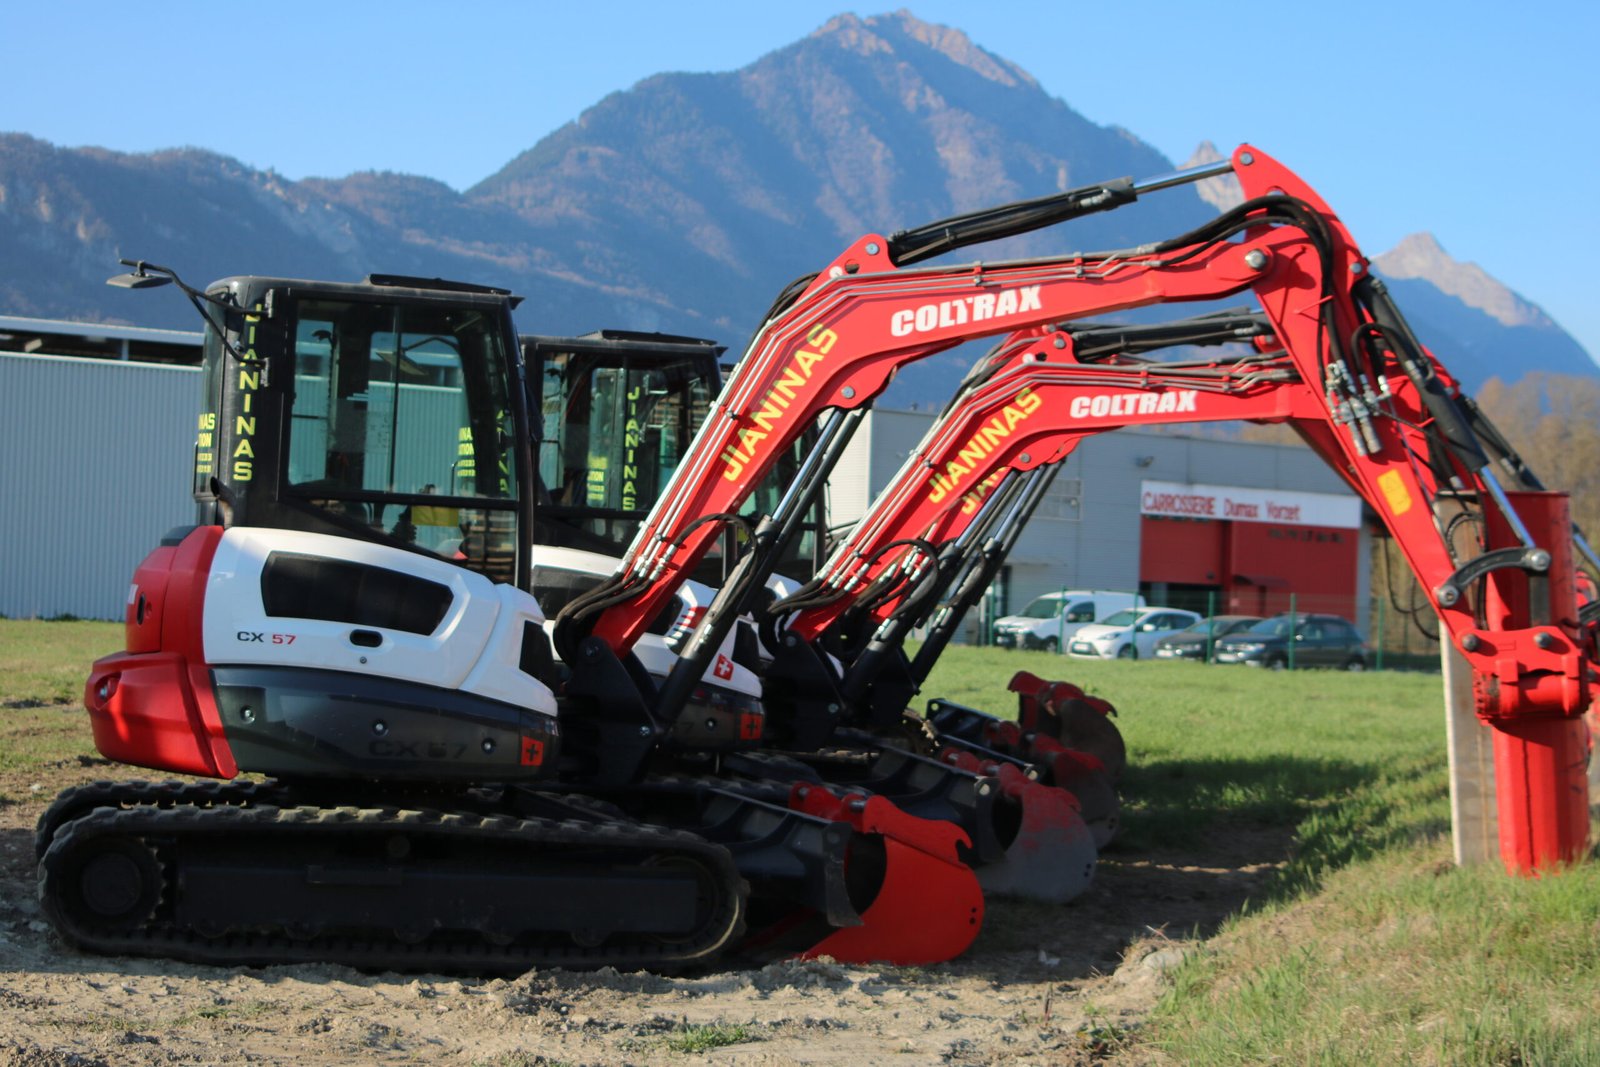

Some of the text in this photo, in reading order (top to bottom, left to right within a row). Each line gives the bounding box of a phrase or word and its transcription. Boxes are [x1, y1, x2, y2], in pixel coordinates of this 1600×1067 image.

[891, 284, 1042, 337] COLTRAX
[233, 304, 262, 481] JIANINAS
[721, 323, 838, 481] JIANINAS
[1070, 390, 1198, 418] COLTRAX
[623, 386, 640, 511] JIANINAS
[929, 387, 1042, 503] JIANINAS
[1143, 491, 1216, 515] CARROSSERIE
[237, 631, 297, 645] CX 57
